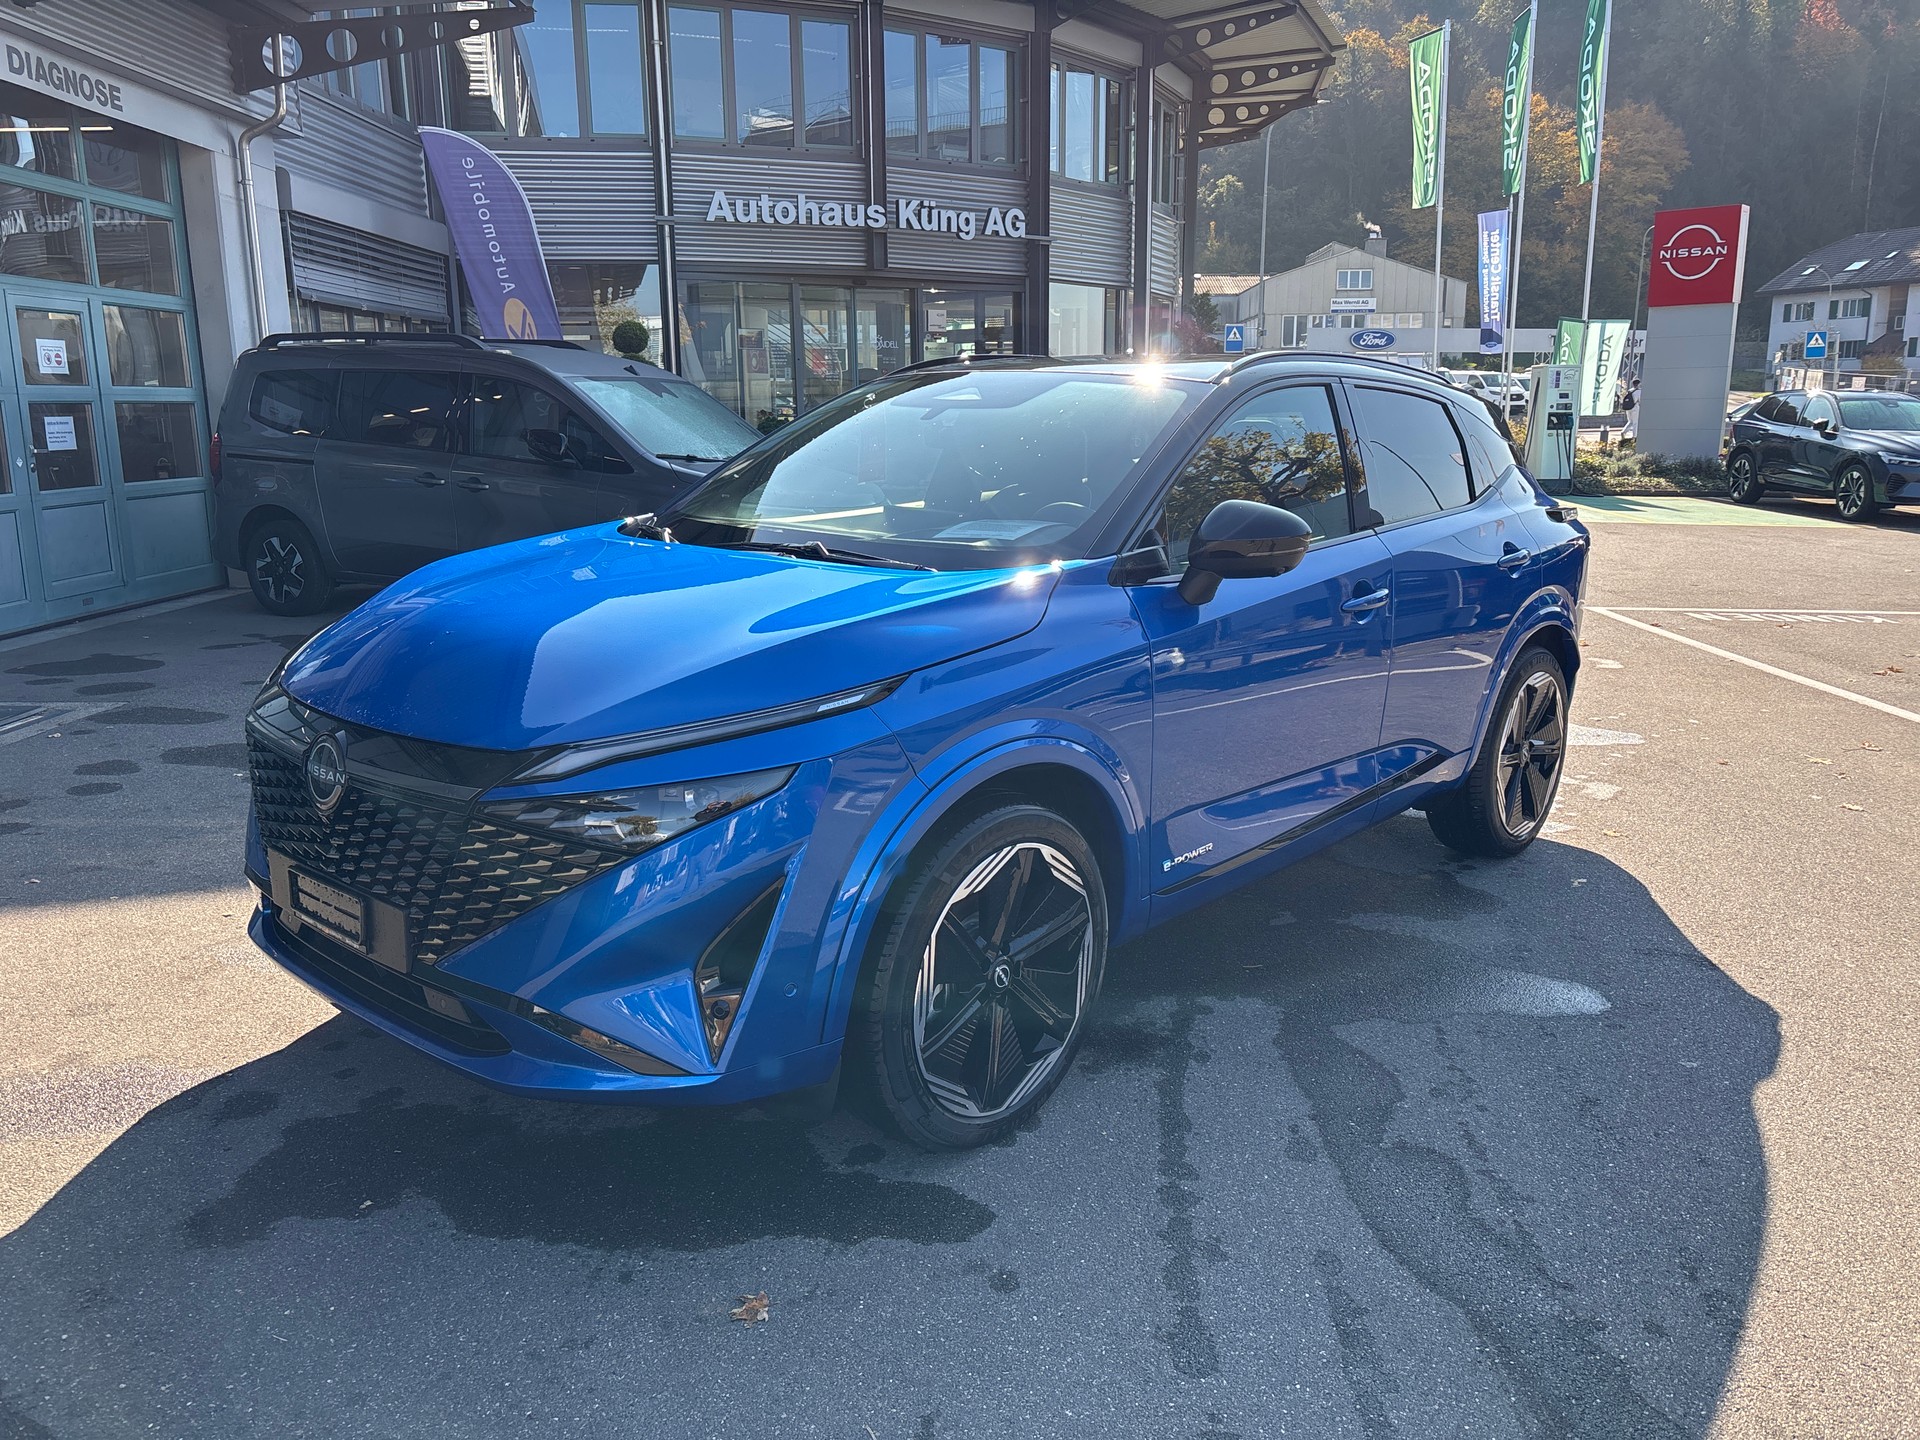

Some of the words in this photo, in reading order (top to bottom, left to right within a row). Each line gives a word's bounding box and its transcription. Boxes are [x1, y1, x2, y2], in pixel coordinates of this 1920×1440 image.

[5, 44, 123, 112] DIAGNOSE
[705, 190, 887, 228] Autohaus
[896, 198, 976, 240] Küng
[984, 207, 1026, 238] AG
[1660, 245, 1728, 259] NISSAN
[307, 760, 345, 784] NISSAN
